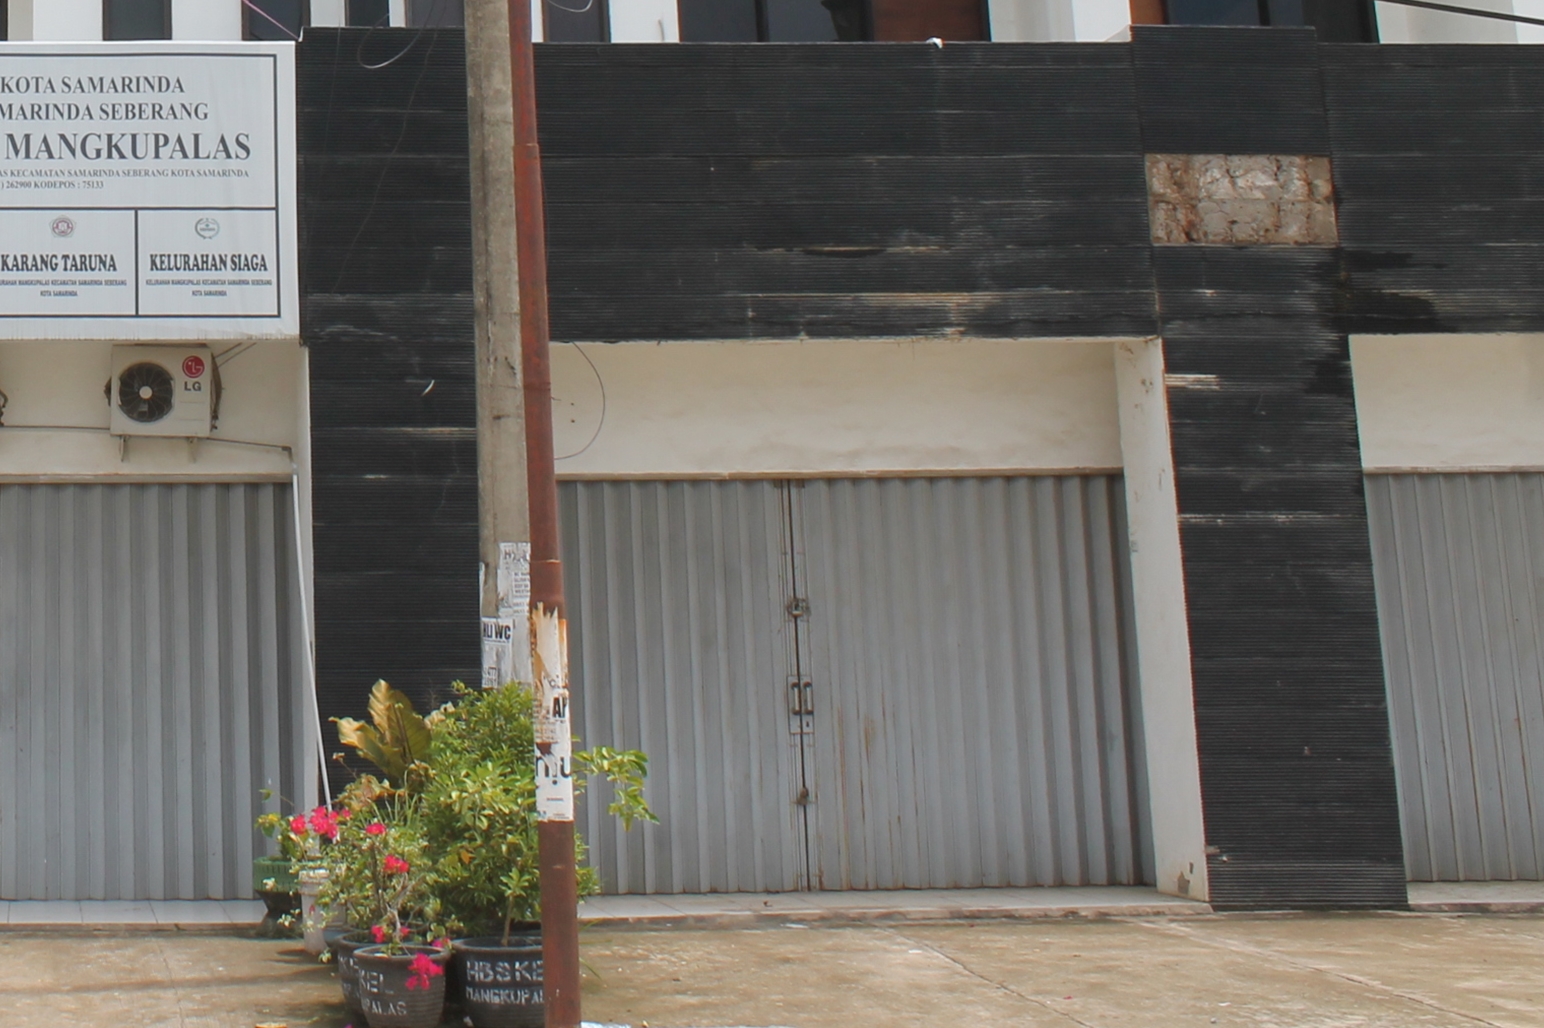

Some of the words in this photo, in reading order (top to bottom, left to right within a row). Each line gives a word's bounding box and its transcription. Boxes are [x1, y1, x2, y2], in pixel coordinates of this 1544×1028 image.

[1, 76, 55, 95] KOTA
[61, 75, 183, 95] SAMARINDA
[99, 103, 207, 121] SEBERANG
[5, 132, 251, 161] MANGKUPALAS
[10, 169, 65, 178] KECAMATAN
[67, 169, 120, 178] SAMARINDA
[122, 169, 168, 178] SEBERANG
[171, 169, 195, 178] KOTA
[197, 169, 248, 178] SAMARINDA
[1, 254, 58, 272] KARANG
[61, 254, 117, 272] TARUNA
[150, 253, 227, 272] KELURAHAN
[230, 253, 268, 272] SIAGA
[184, 381, 202, 391] LG
